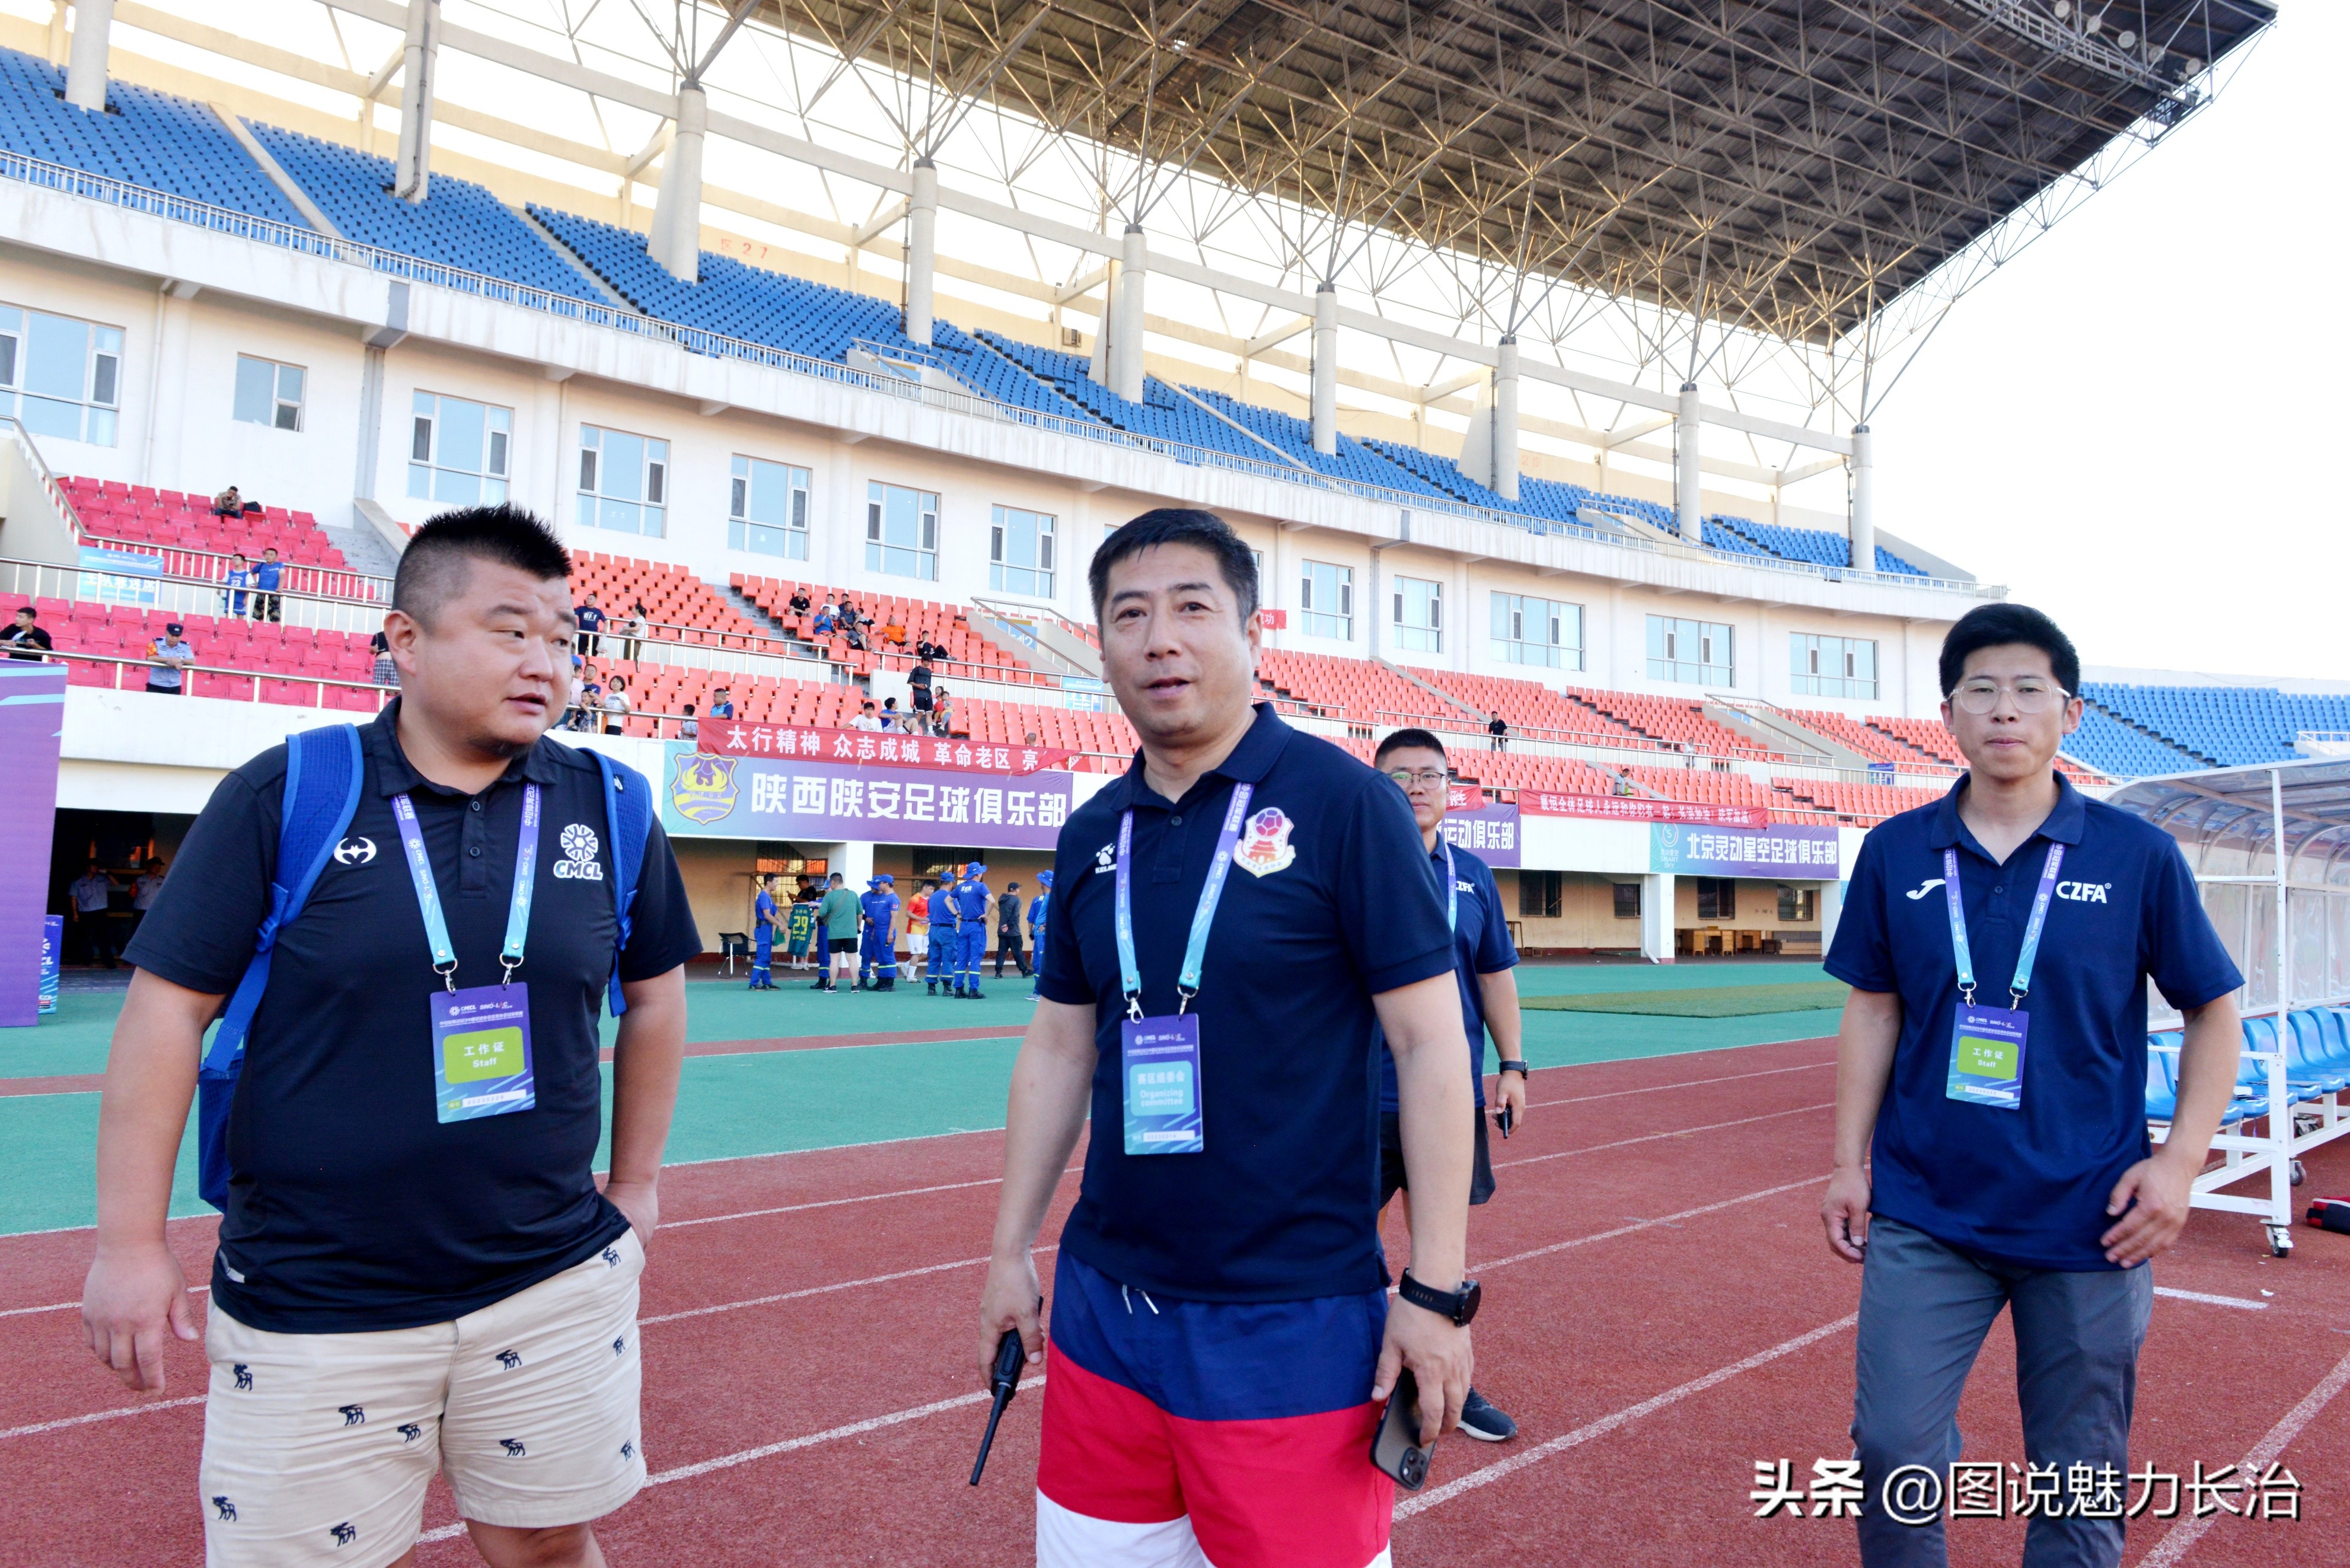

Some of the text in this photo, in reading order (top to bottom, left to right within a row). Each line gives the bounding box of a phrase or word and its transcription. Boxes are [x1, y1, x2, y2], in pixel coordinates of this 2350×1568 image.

[727, 729, 1047, 771] 太行精神 众志成城 革命老区 亮
[751, 773, 1066, 827] 陕西陕安足球俱乐部
[1687, 833, 1837, 865] 北京灵动星空足球俱乐部
[415, 849, 425, 865] CMCL
[553, 860, 603, 880] CMCL
[1095, 863, 1117, 874] KELME
[1456, 881, 1475, 894] ZFA
[2056, 881, 2107, 904] CZFA
[793, 916, 808, 935] 29
[464, 1042, 504, 1056] 工作证
[1972, 1048, 2004, 1059] 工作证
[473, 1057, 497, 1068] Staff
[1978, 1059, 1996, 1067] Staff
[1140, 1089, 1184, 1099] Organizing
[1141, 1098, 1183, 1107] committee
